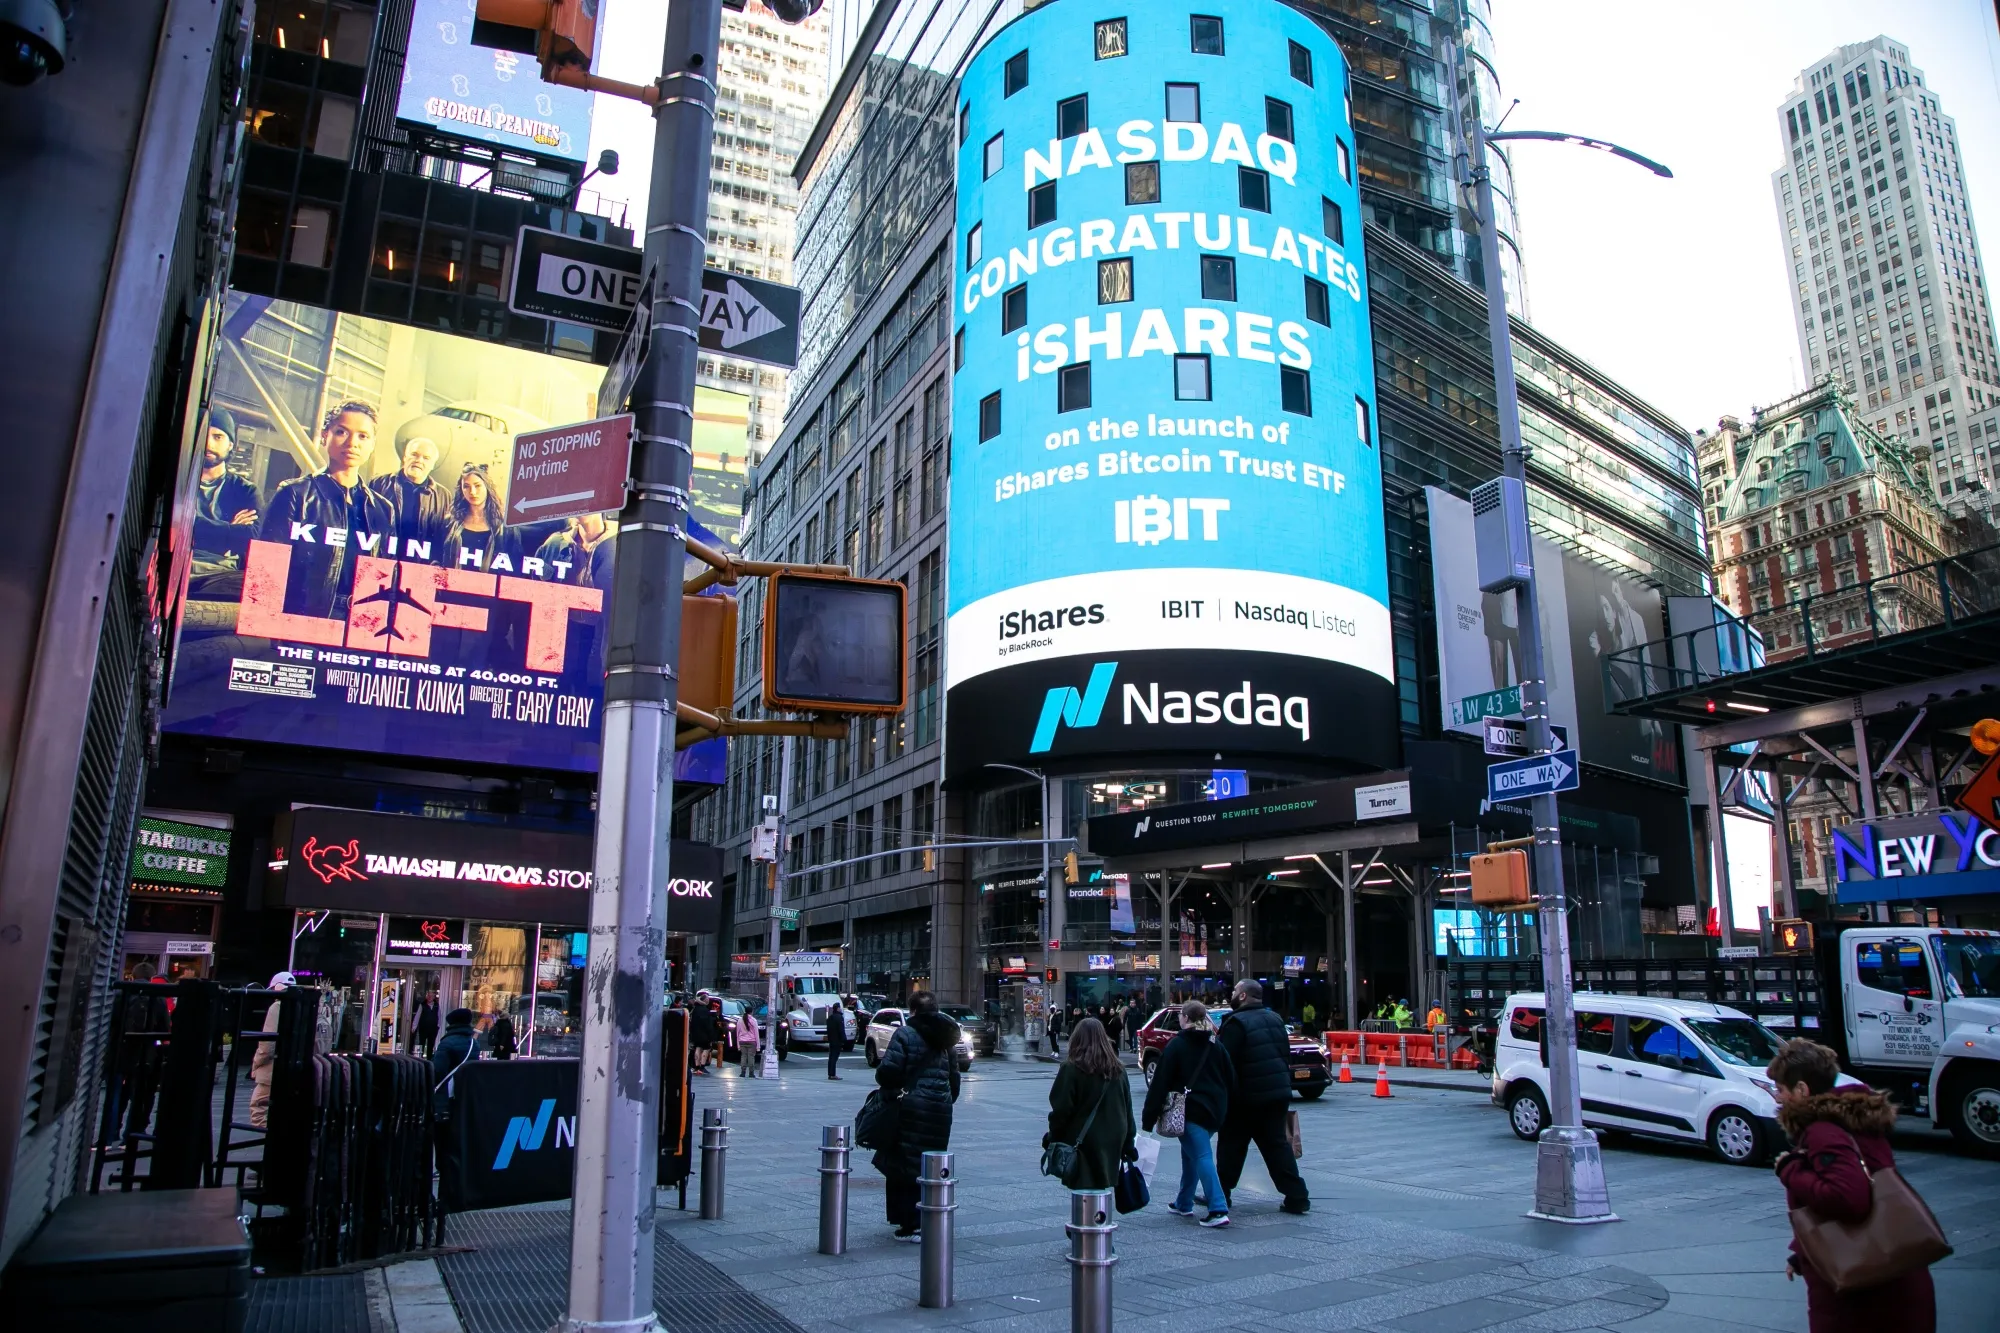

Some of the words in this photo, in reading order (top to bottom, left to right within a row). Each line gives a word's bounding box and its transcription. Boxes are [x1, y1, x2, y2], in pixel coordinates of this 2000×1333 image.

[427, 97, 493, 128] GEORGIA
[495, 111, 560, 141] PEANUTS
[1024, 119, 1297, 192] NASDAQ
[963, 212, 1360, 314] CONGRATULATES
[525, 304, 545, 312] DEPT
[561, 264, 642, 307] ONE
[701, 293, 760, 333] AY
[1017, 308, 1312, 382] iSHARES
[519, 442, 537, 460] NO
[541, 430, 602, 456] STOPPING
[1044, 427, 1081, 451] on
[1087, 417, 1139, 442] the
[1147, 413, 1254, 440] launch
[1261, 422, 1289, 445] of
[517, 459, 569, 481] Anytime
[995, 459, 1089, 503] iShares
[1099, 448, 1212, 476] Bitcoin
[1219, 449, 1297, 482] Trust
[1302, 461, 1345, 495] ETF
[290, 521, 431, 561] KEVIN
[459, 545, 573, 581] HART
[235, 539, 603, 673] LIFT
[1161, 600, 1204, 619] IBIT
[1235, 600, 1308, 630] Nasdaq
[1313, 610, 1356, 637] Listed
[1458, 613, 1476, 625] DRESS
[999, 603, 1105, 640] iShares
[999, 648, 1008, 656] by
[1009, 637, 1053, 653] BlackRock
[232, 670, 269, 684] PG-13
[278, 646, 314, 660] THE
[318, 648, 371, 667] HEIST
[375, 658, 441, 675] BEGINS
[445, 666, 466, 678] AT
[470, 670, 532, 686] 40,000
[537, 677, 558, 689] FT.
[326, 668, 360, 688] WRITTEN
[347, 687, 359, 703] BY
[360, 672, 411, 710] DANIEL
[416, 679, 465, 715] KUNKA
[469, 685, 503, 703] DIRECTED
[1465, 699, 1479, 720] W
[1486, 693, 1503, 715] 43
[492, 702, 503, 719] BY
[503, 689, 513, 720] F.
[516, 690, 554, 724] GARY
[556, 695, 594, 728] GRAY
[1122, 681, 1310, 741] Nasdaq
[1497, 729, 1521, 744] ONE
[1501, 771, 1526, 788] ONE
[1537, 764, 1563, 782] WAY
[1369, 798, 1397, 808] Turner
[1496, 804, 1523, 814] QUESTION
[1155, 817, 1191, 828] QUESTION
[1193, 813, 1217, 823] TODAY
[1222, 807, 1259, 820] REWRITE
[137, 829, 228, 856] TARBUCKS
[1938, 814, 2000, 873] YO
[143, 853, 207, 874] COFFEE
[365, 854, 456, 879] TAMASHII
[548, 868, 593, 889] STOR
[1016, 878, 1040, 886] TOMORRO
[1141, 920, 1179, 931] Nasaq
[782, 956, 813, 967] AABCO
[813, 956, 832, 967] ASM
